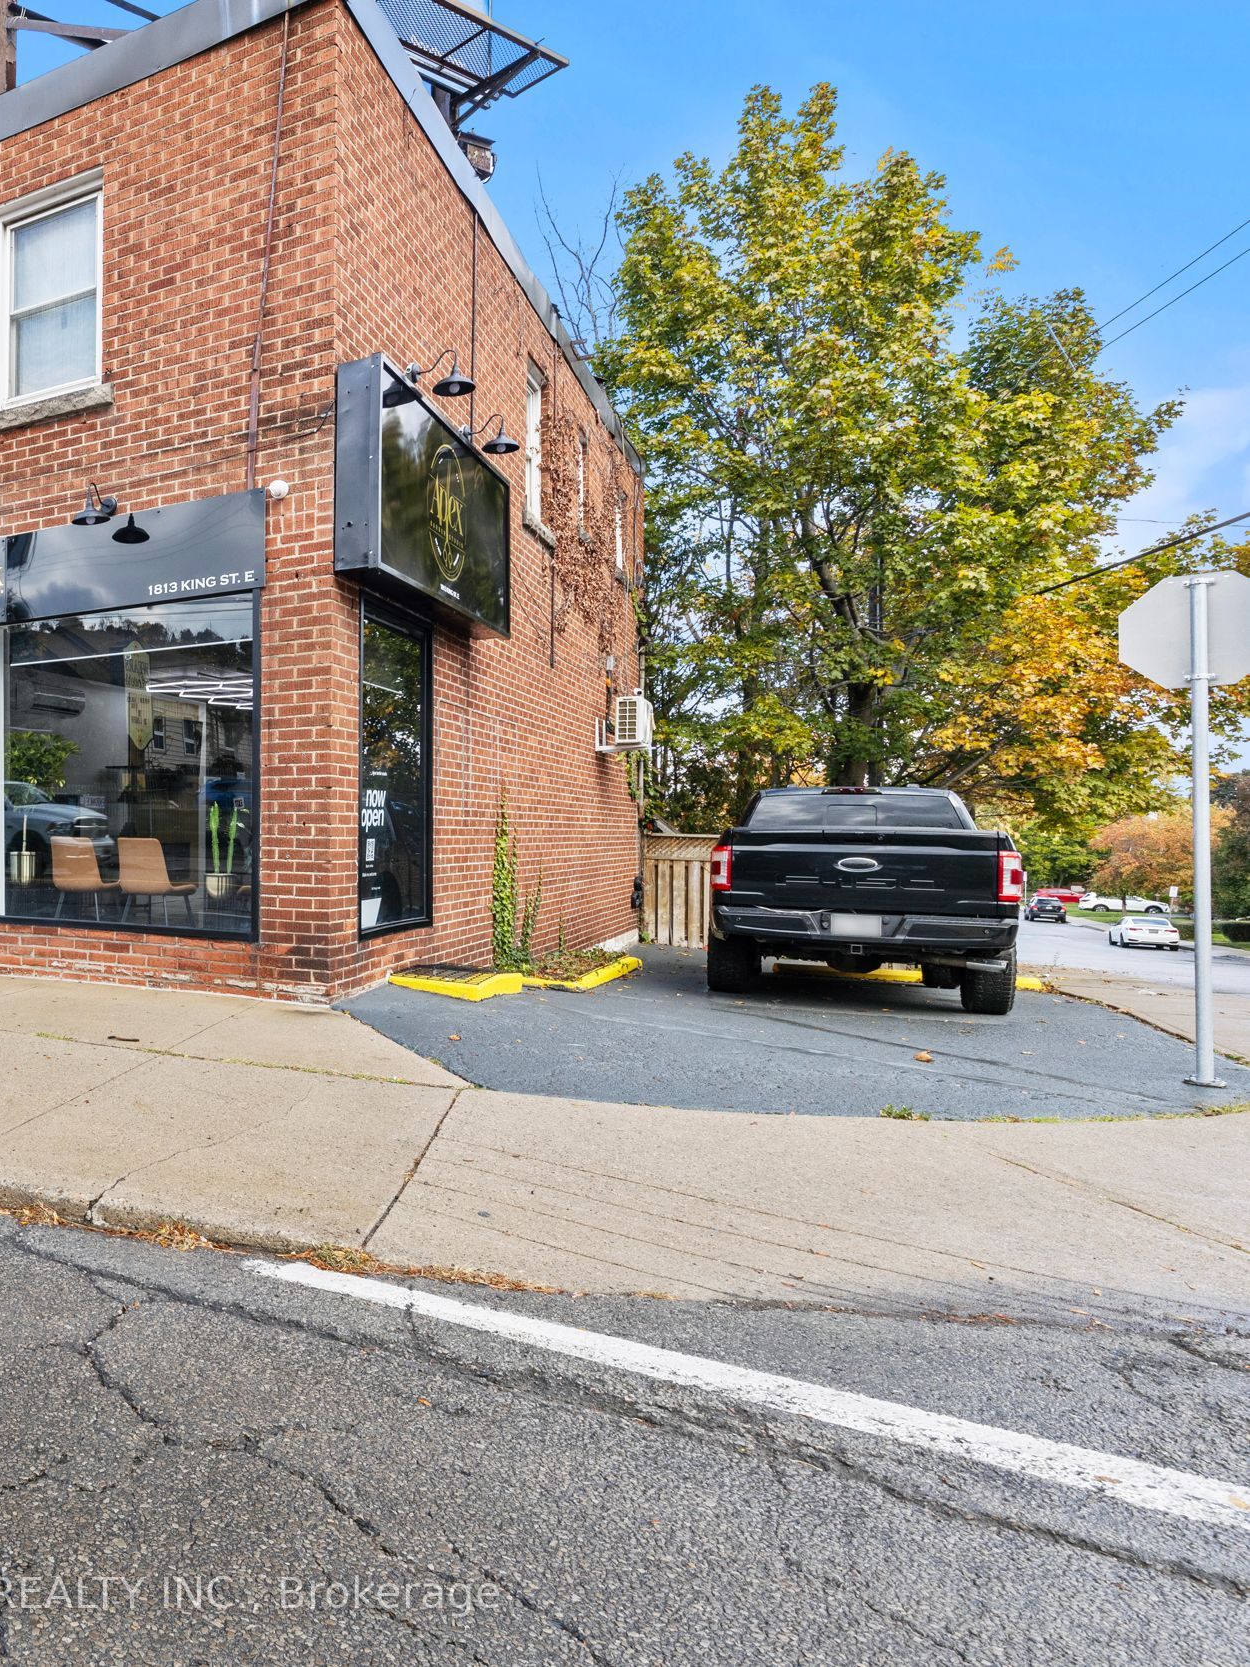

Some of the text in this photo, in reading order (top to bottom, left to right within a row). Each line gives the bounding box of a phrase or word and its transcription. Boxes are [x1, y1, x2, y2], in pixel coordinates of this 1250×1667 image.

[148, 570, 255, 596] 1813 KING ST. E
[366, 789, 386, 807] now
[361, 808, 384, 832] open
